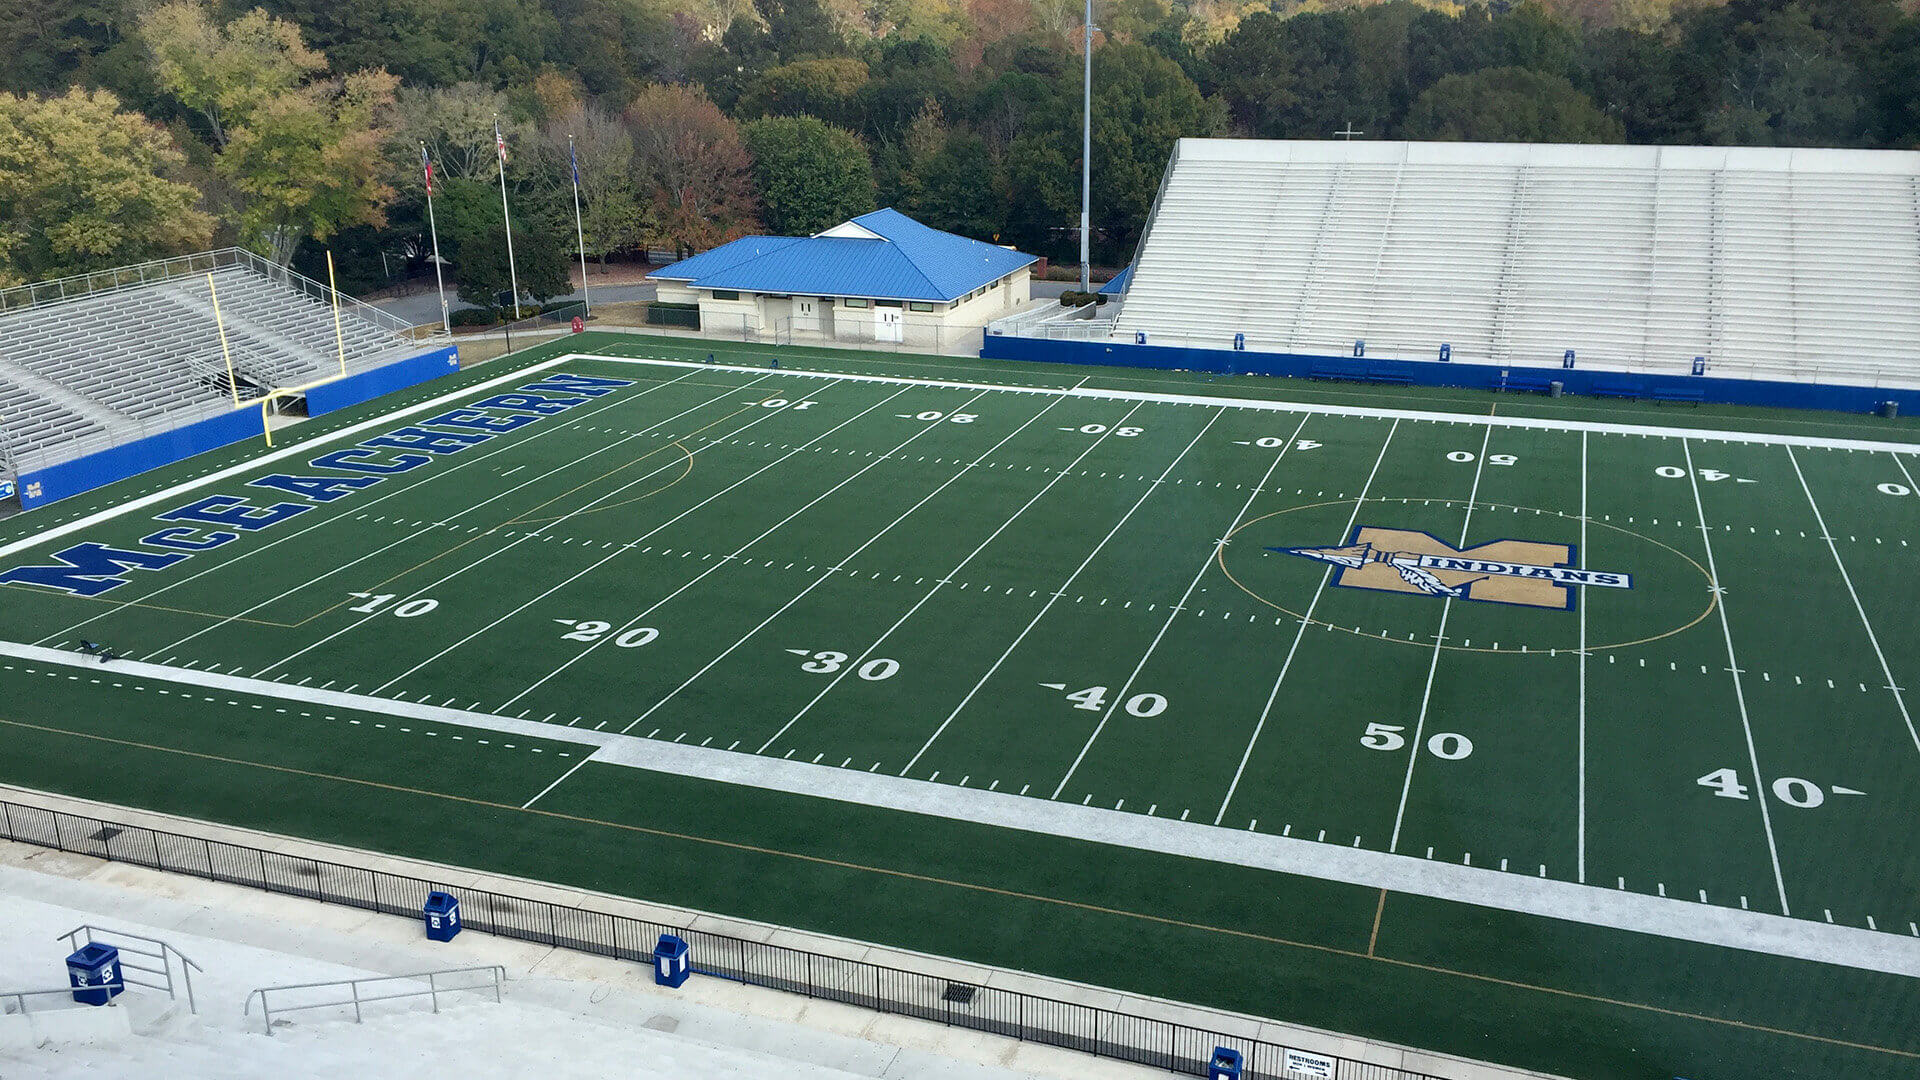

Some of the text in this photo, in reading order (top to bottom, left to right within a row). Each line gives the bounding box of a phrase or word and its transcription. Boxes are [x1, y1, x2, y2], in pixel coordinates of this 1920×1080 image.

[756, 398, 819, 411] 10
[915, 410, 979, 424] 20
[1073, 424, 1145, 437] 30
[1255, 437, 1323, 450] 40
[1446, 451, 1519, 467] 50
[1655, 466, 1732, 482] 40
[1429, 556, 1621, 586] INDIANS
[349, 594, 439, 618] 10
[561, 620, 660, 649] 20
[801, 650, 901, 682] 30
[1063, 685, 1169, 720] 40
[1359, 721, 1474, 761] 50
[1696, 767, 1825, 809] 40
[1289, 1054, 1331, 1068] RESTROOMS
